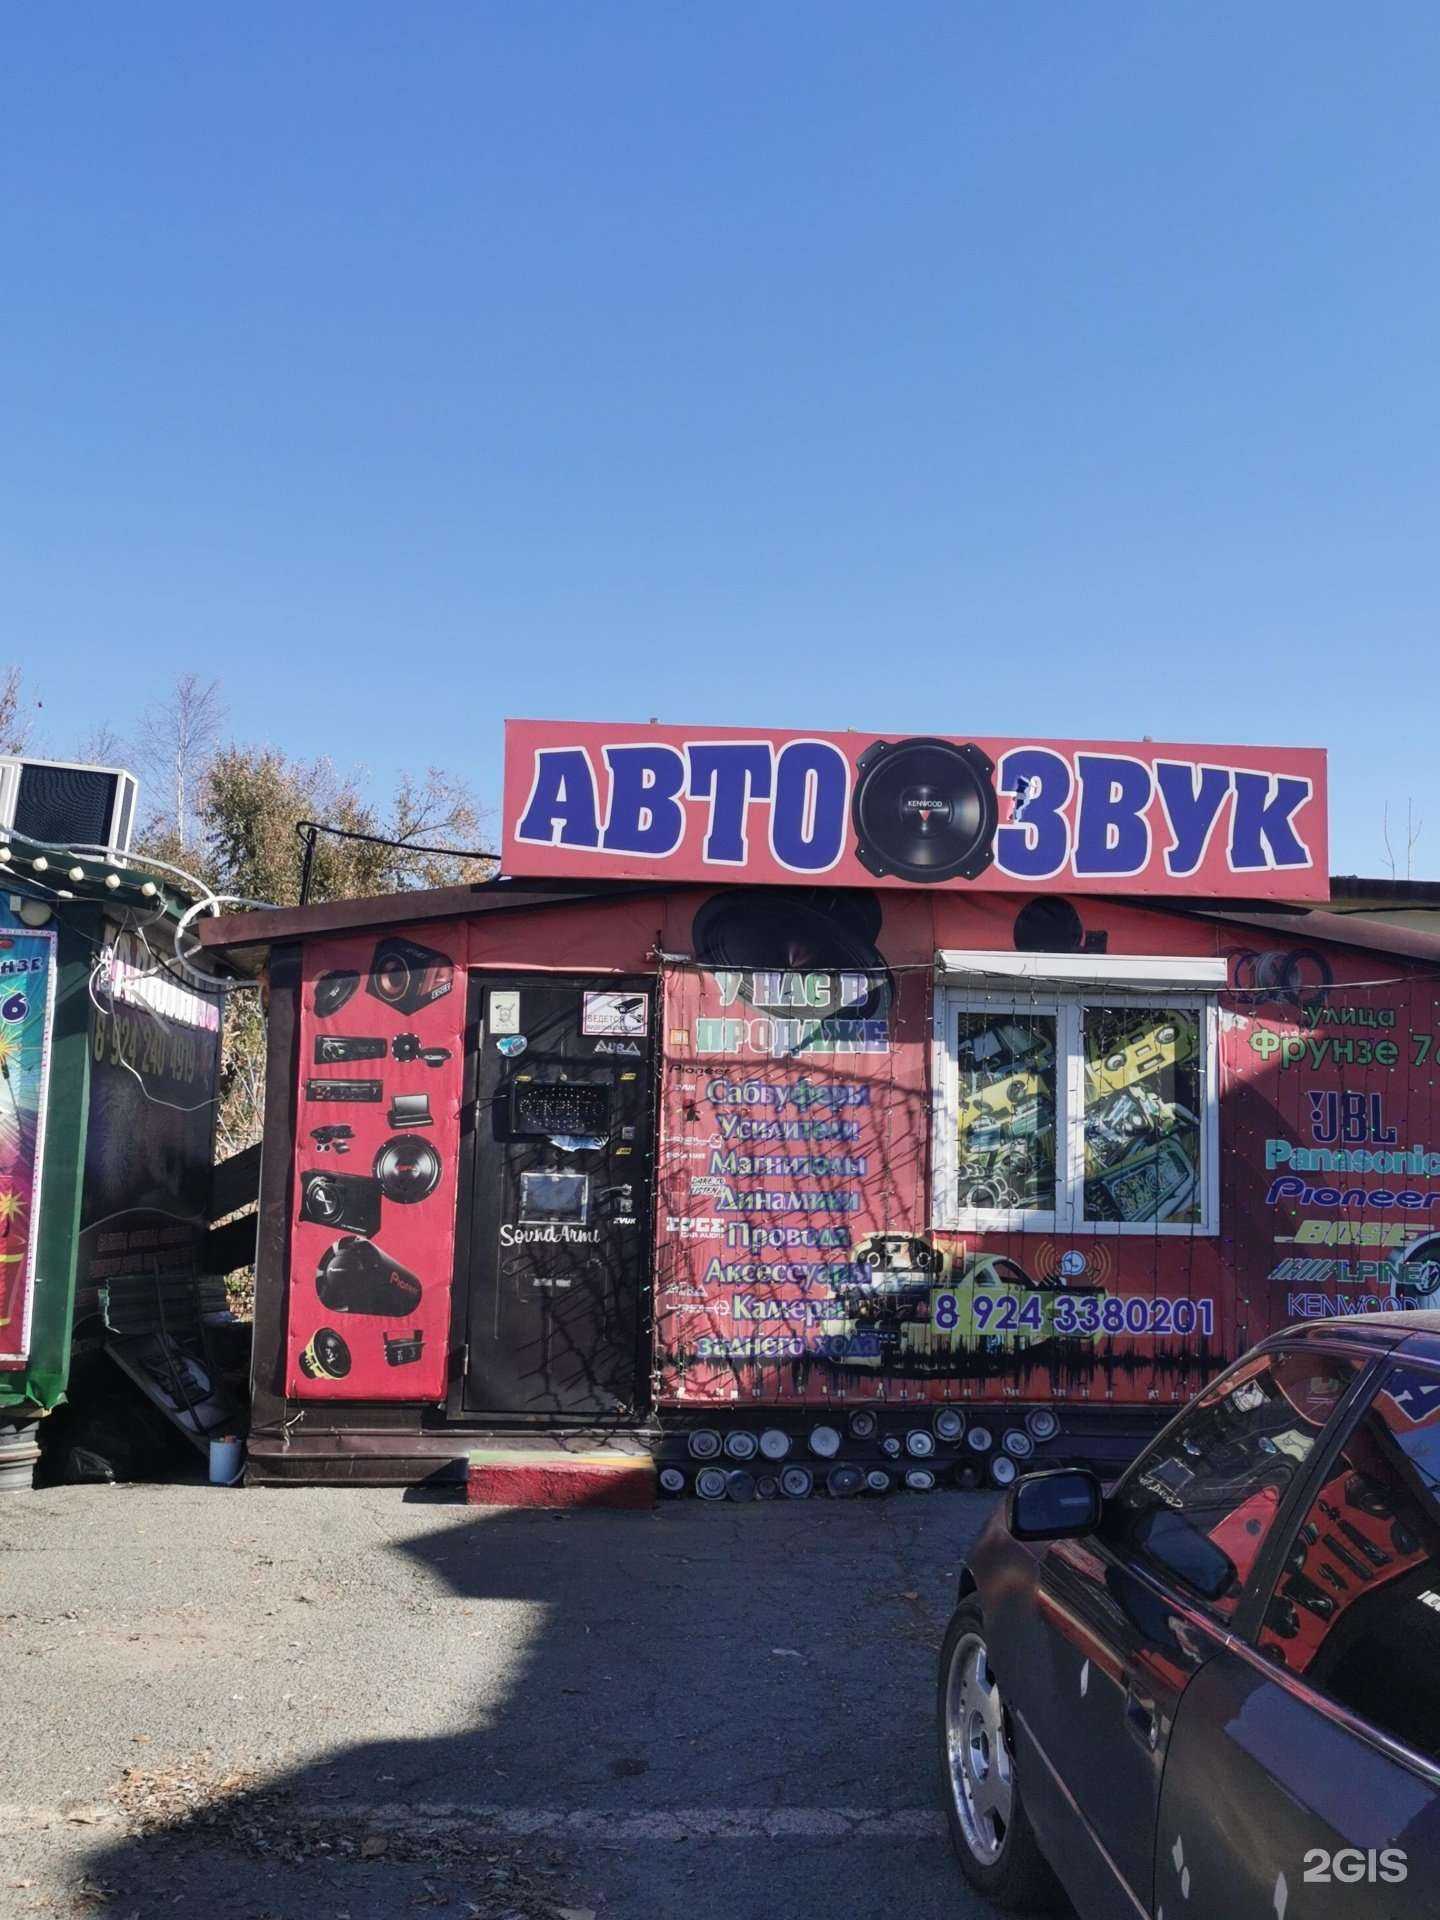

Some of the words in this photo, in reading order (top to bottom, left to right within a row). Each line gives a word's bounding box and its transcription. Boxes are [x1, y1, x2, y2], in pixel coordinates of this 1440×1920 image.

[514, 739, 848, 873] АВТО
[994, 745, 1313, 880] ЗВУК
[907, 800, 943, 808] KENWOOD
[714, 971, 743, 1006] У
[752, 972, 831, 1007] НАС
[840, 973, 868, 1007] В
[1307, 1005, 1397, 1029] улица
[696, 1018, 889, 1058] ПРОДАЖЕ
[1250, 1028, 1400, 1071] Фрунзе
[1412, 1034, 1440, 1067] 7
[706, 1076, 871, 1112] Сабвуферы
[716, 1112, 861, 1141] Усилители
[1308, 1090, 1398, 1144] JBL
[709, 1150, 868, 1177] Магнитолы
[1265, 1139, 1440, 1176] Panasonic
[716, 1184, 861, 1212] Динамики
[1265, 1175, 1440, 1210] Pioneer
[726, 1221, 850, 1254] Провода
[1274, 1220, 1434, 1246] BOSE
[703, 1257, 872, 1292] Аксессуары
[934, 1294, 960, 1331] 8
[973, 1294, 1044, 1332] 924
[1054, 1295, 1214, 1336] 3380201
